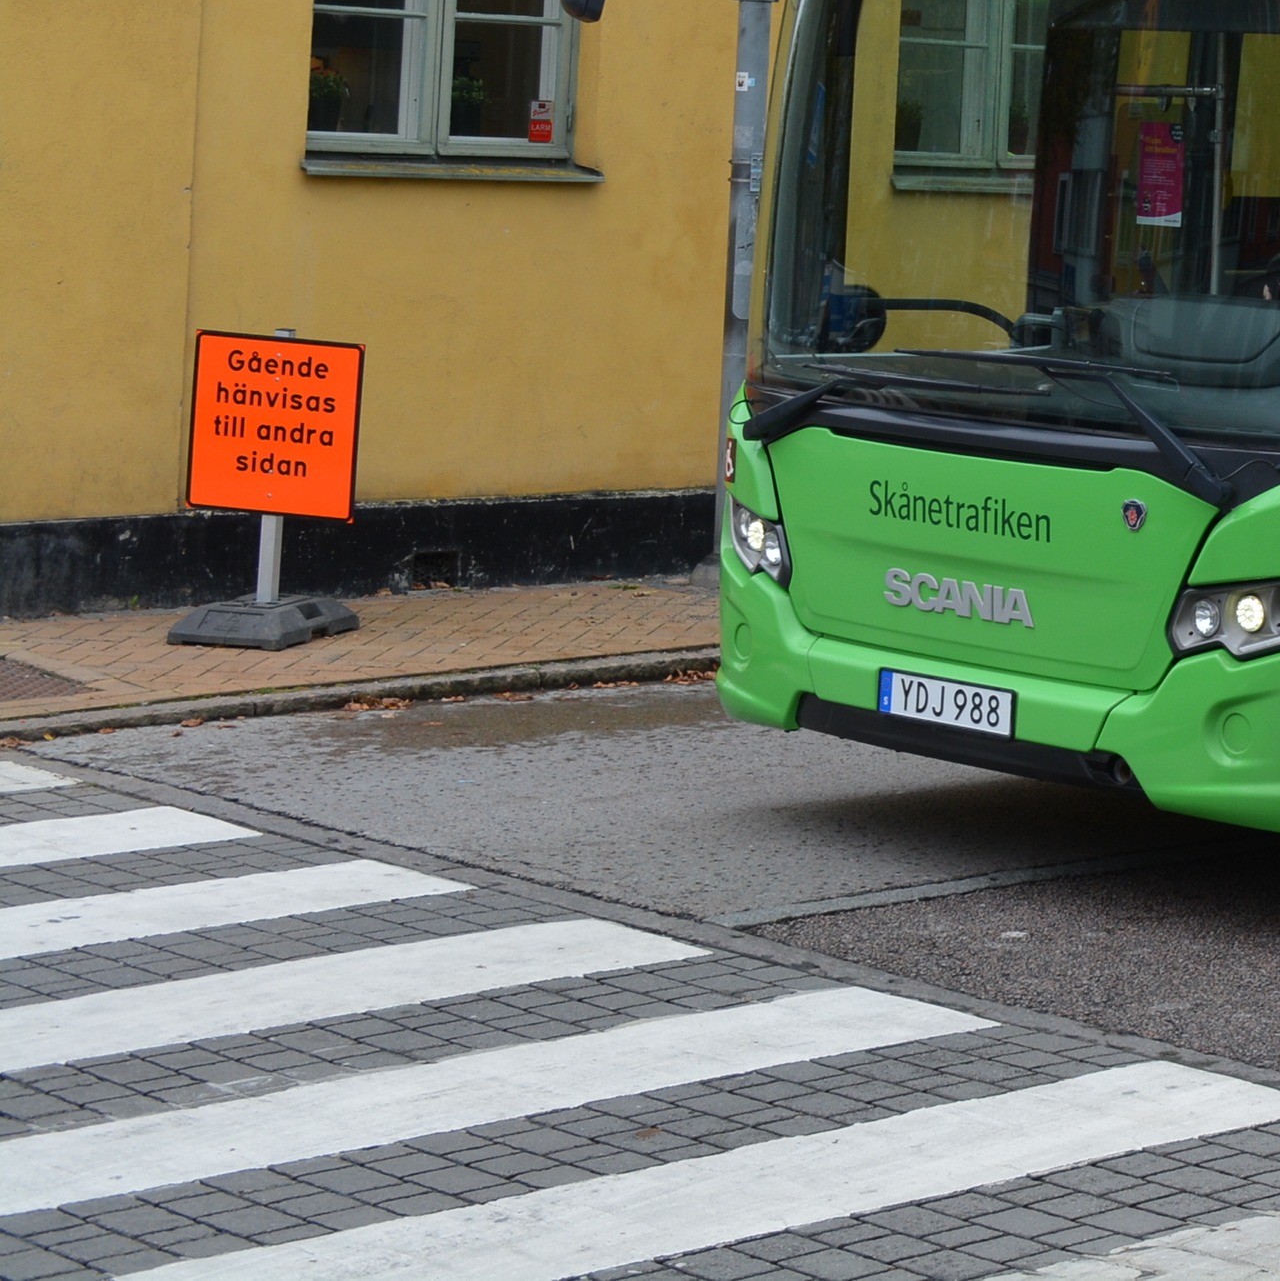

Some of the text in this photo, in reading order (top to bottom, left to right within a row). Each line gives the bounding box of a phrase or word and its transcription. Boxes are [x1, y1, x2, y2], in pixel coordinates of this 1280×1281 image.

[228, 349, 329, 379] Gående
[216, 381, 336, 414] hänvisas
[214, 415, 334, 447] till andra
[236, 451, 308, 477] sidan
[869, 480, 1051, 543] Skånetrafiken
[883, 567, 1036, 630] SCANIA
[901, 677, 1000, 728] YDJ 988
